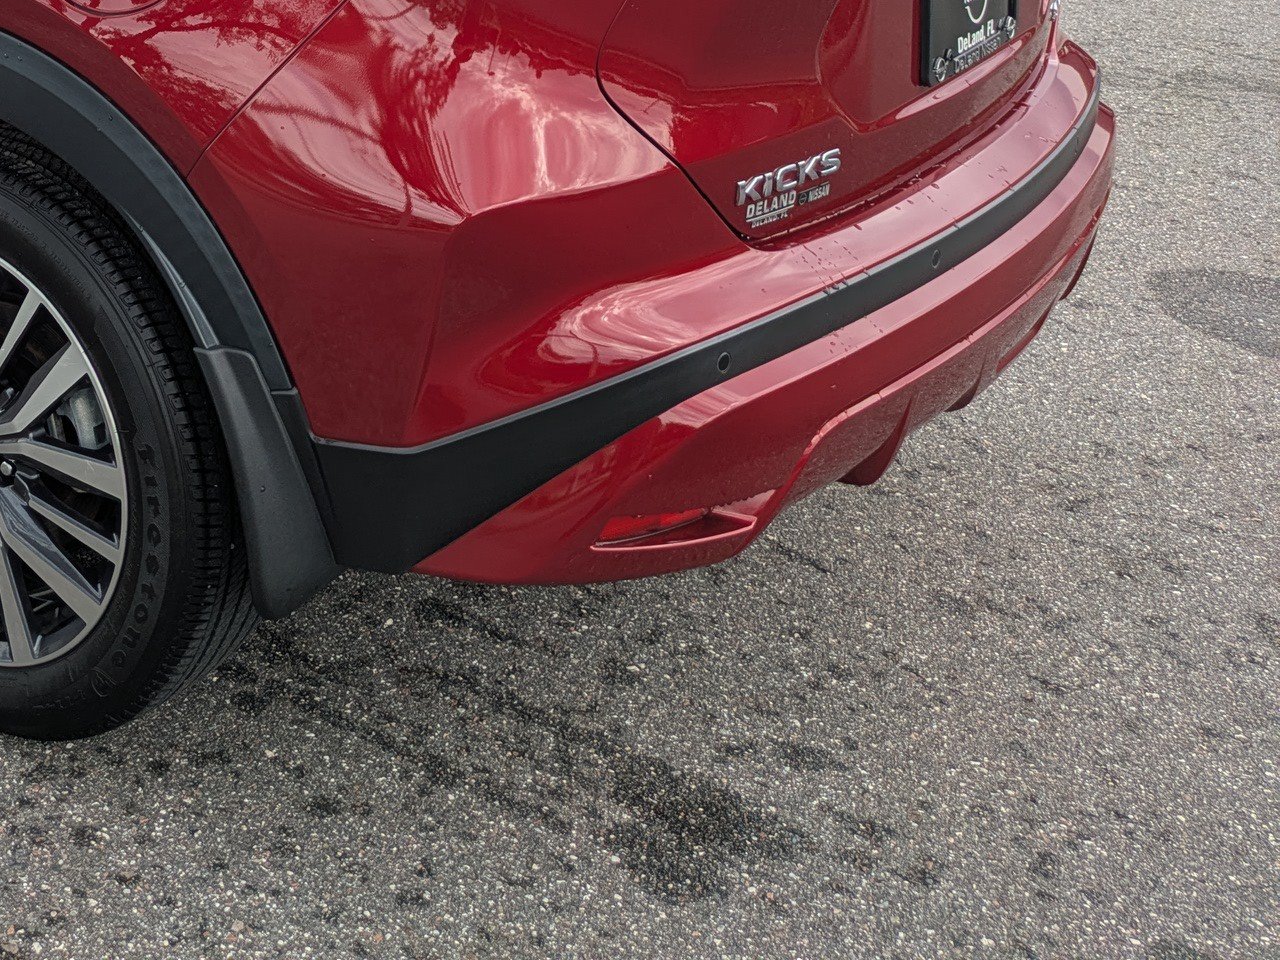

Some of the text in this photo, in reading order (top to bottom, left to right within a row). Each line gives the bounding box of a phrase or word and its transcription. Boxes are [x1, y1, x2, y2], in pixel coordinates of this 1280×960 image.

[957, 18, 995, 54] DeLand, FL
[736, 148, 842, 207] KICKS
[746, 183, 830, 219] DELAND NISSAN
